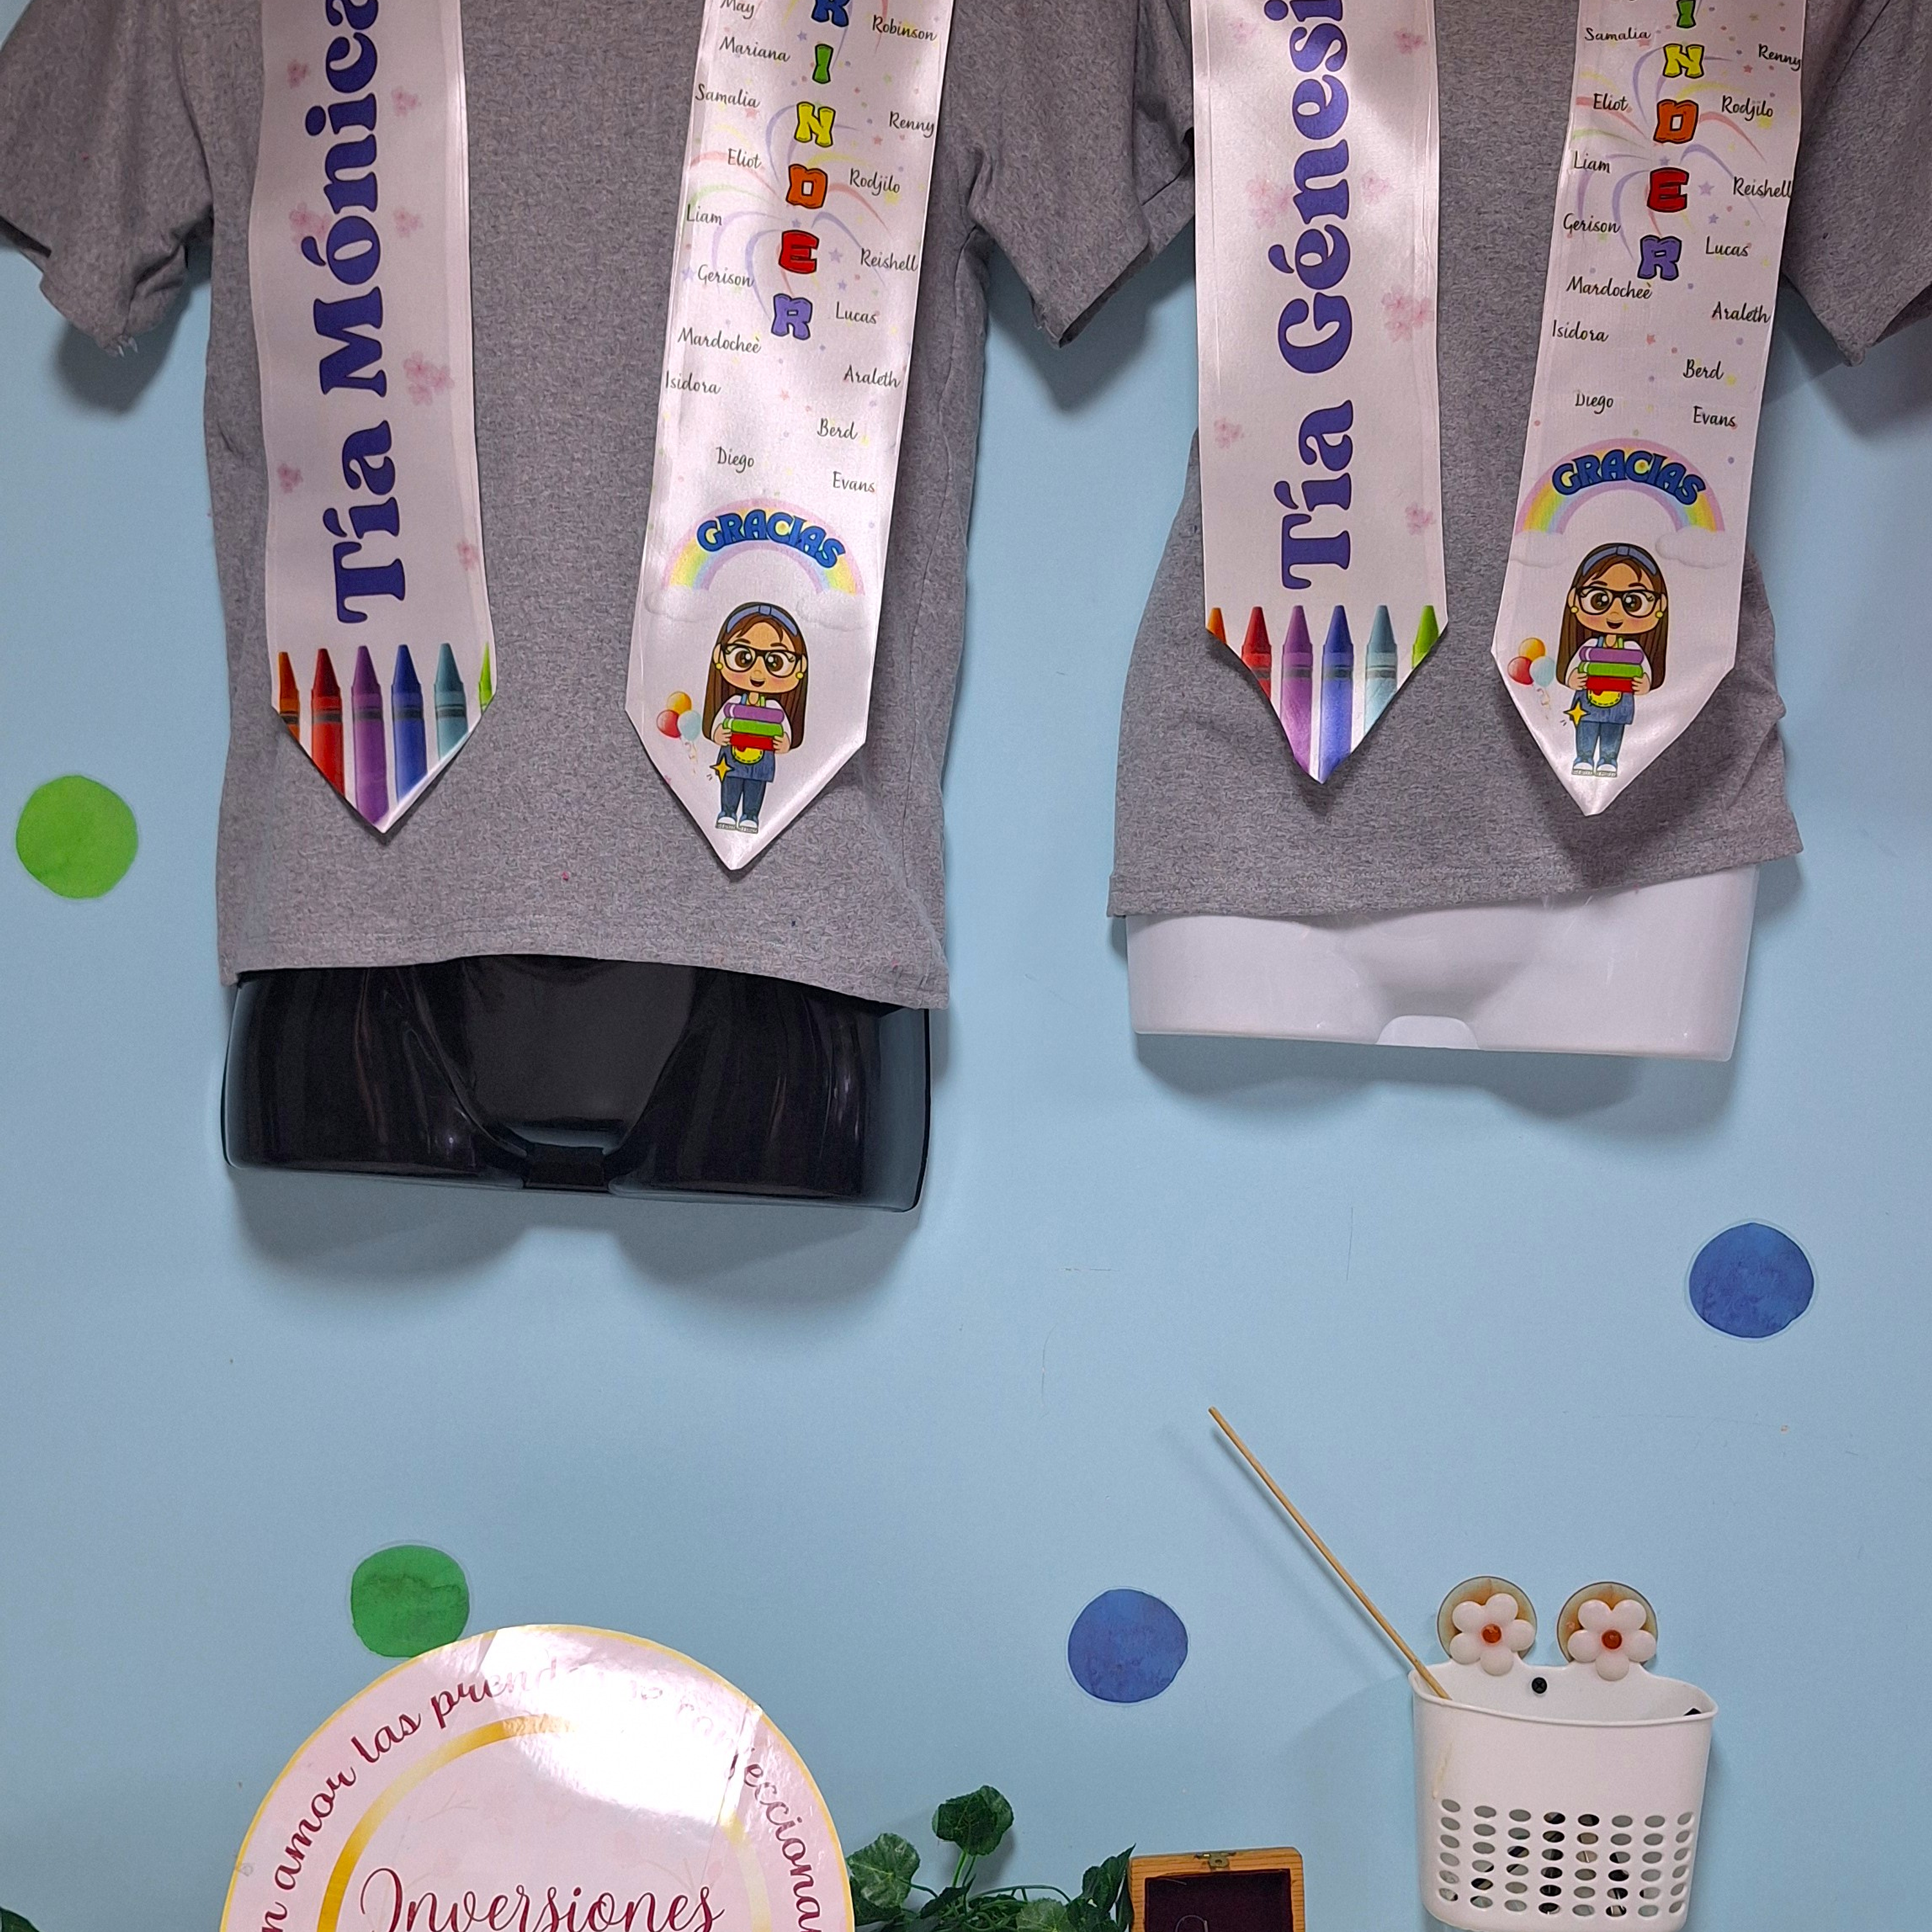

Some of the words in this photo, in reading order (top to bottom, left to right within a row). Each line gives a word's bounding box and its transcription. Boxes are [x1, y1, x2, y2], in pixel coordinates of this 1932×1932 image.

[720, 0, 755, 19] May
[873, 15, 937, 41] Robinson
[1584, 27, 1651, 41] Samalia
[719, 36, 790, 62] Mariana
[1758, 44, 1802, 71] Renny
[695, 84, 761, 108] Samalia
[1593, 93, 1628, 111] Eliot
[1722, 95, 1773, 121] Rodjilo
[889, 111, 935, 138] Renny
[728, 148, 762, 169] Eliot
[1573, 151, 1611, 173] Liam
[849, 169, 900, 194] Rodjilo
[1733, 177, 1792, 199] Reishell
[687, 204, 723, 225] Liam
[1563, 213, 1622, 233] Gerison
[1705, 236, 1750, 257] Lucas
[860, 248, 918, 272] Reishell
[697, 264, 754, 288] Gerison
[836, 301, 878, 325] Lucas
[1712, 301, 1770, 323] Araleth
[1553, 319, 1609, 342] Isidora
[844, 365, 902, 388] Araleth
[1683, 359, 1724, 380] Berd
[665, 371, 721, 395] Isidora
[1575, 392, 1613, 414] Diego
[817, 418, 858, 440] Berd
[1693, 406, 1736, 428] Evans
[716, 446, 754, 473] Diego
[833, 471, 875, 493] Evans
[1552, 449, 1706, 506] GRACIAS
[1273, 400, 1353, 590] Tía
[323, 420, 405, 624] Tía
[697, 509, 846, 569] GRACIAS
[274, 1766, 357, 1890] amor
[351, 1712, 421, 1763] las
[361, 1868, 725, 1932] Inversiones
